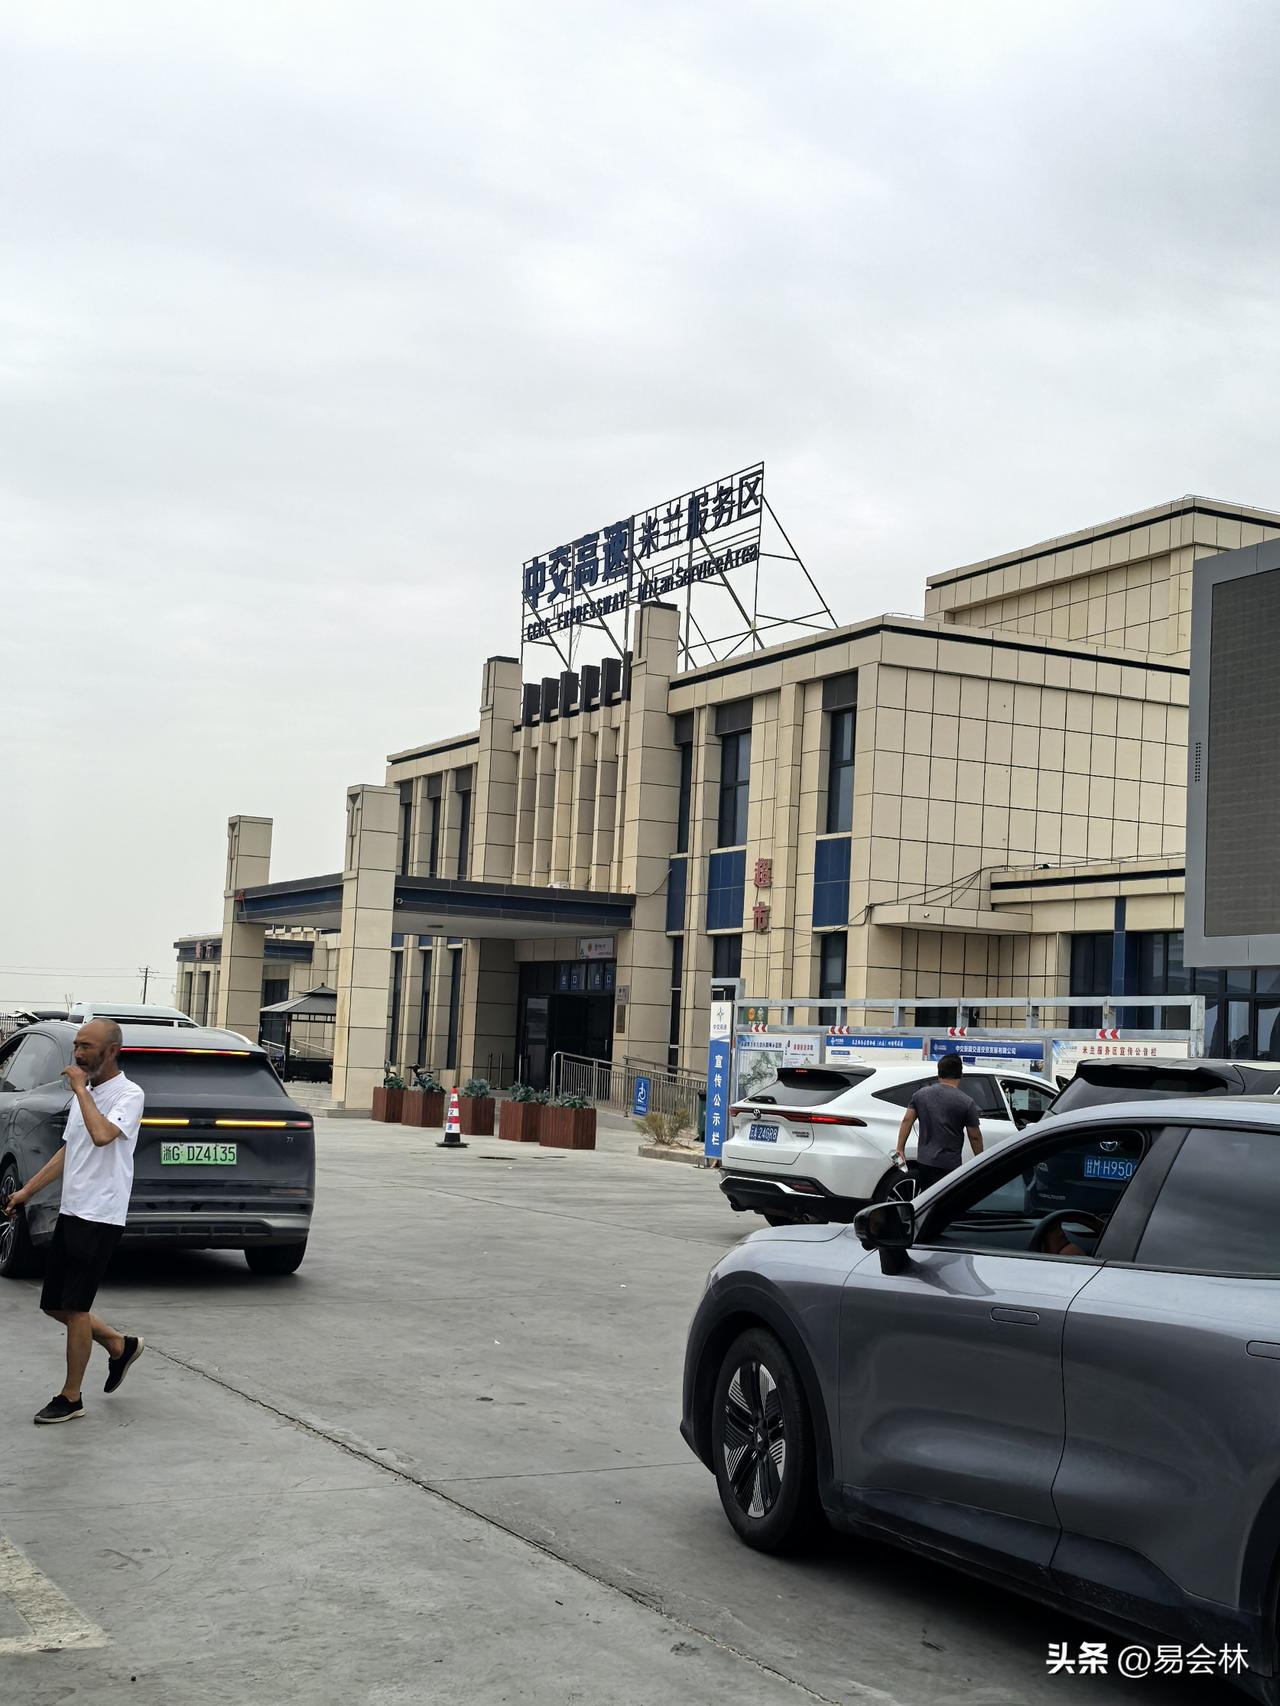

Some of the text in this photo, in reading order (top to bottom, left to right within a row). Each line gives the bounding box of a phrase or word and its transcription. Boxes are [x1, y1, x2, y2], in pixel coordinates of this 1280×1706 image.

[524, 469, 763, 609] 中交高速 米兰服务区
[556, 588, 627, 632] EXPRESSWAY
[711, 1054, 723, 1146] 宣传公示栏
